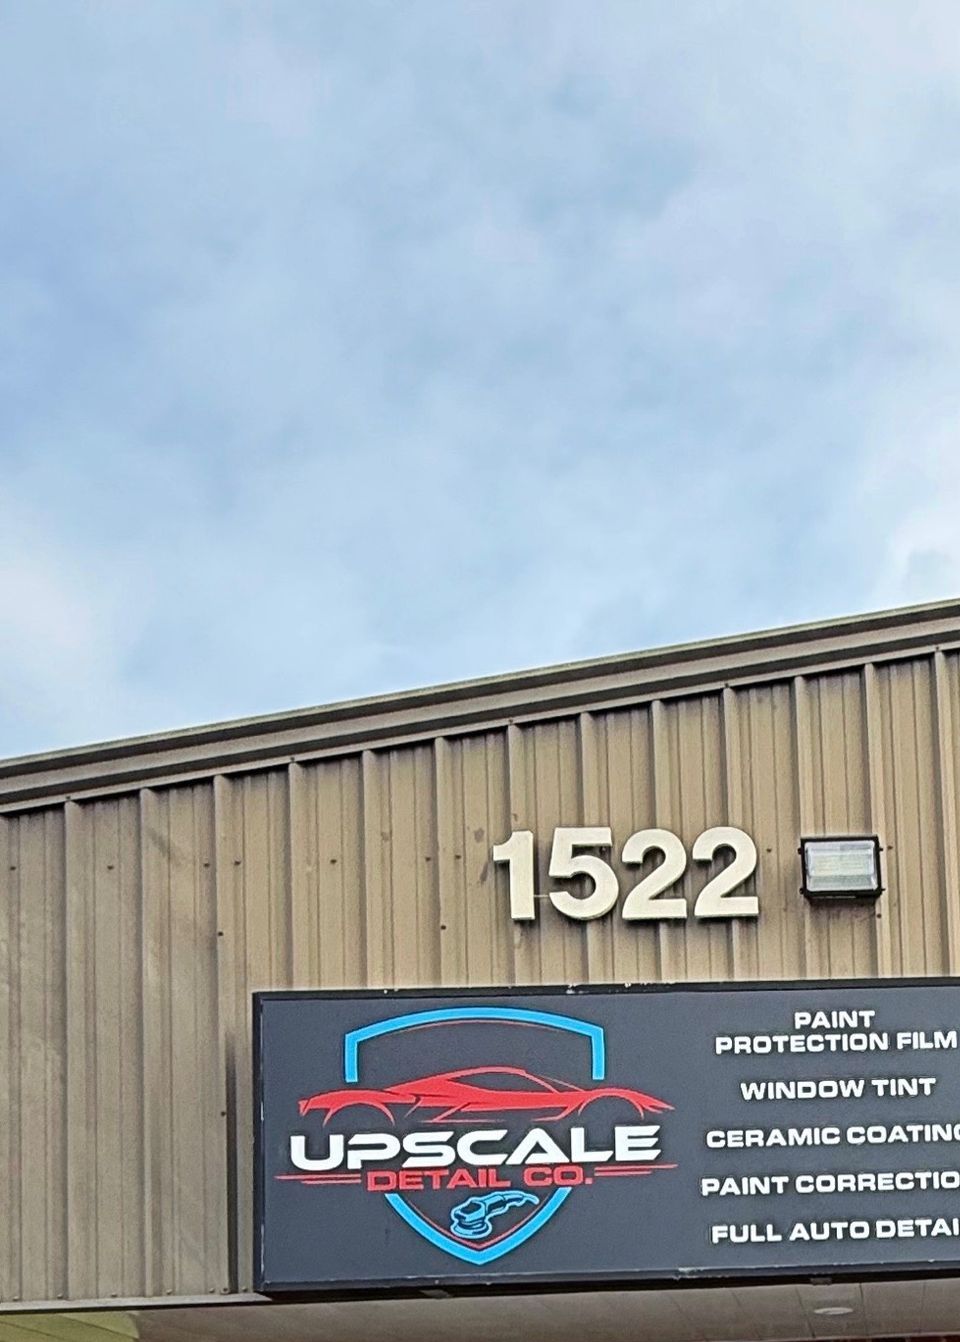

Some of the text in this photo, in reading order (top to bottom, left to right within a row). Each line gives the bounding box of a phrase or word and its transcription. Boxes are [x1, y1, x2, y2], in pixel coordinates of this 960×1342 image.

[493, 826, 759, 920] 1522
[794, 1009, 876, 1030] PAINT
[715, 1030, 959, 1055] PROTECTION FILM
[740, 1077, 937, 1101] WINDOW TINT
[289, 1124, 662, 1172] UPSCALE
[706, 1127, 841, 1149] CERAMIC
[366, 1165, 594, 1192] DETAIL CO.
[701, 1175, 789, 1197] PAINT
[711, 1223, 783, 1244] FULL
[788, 1220, 871, 1242] AUTO
